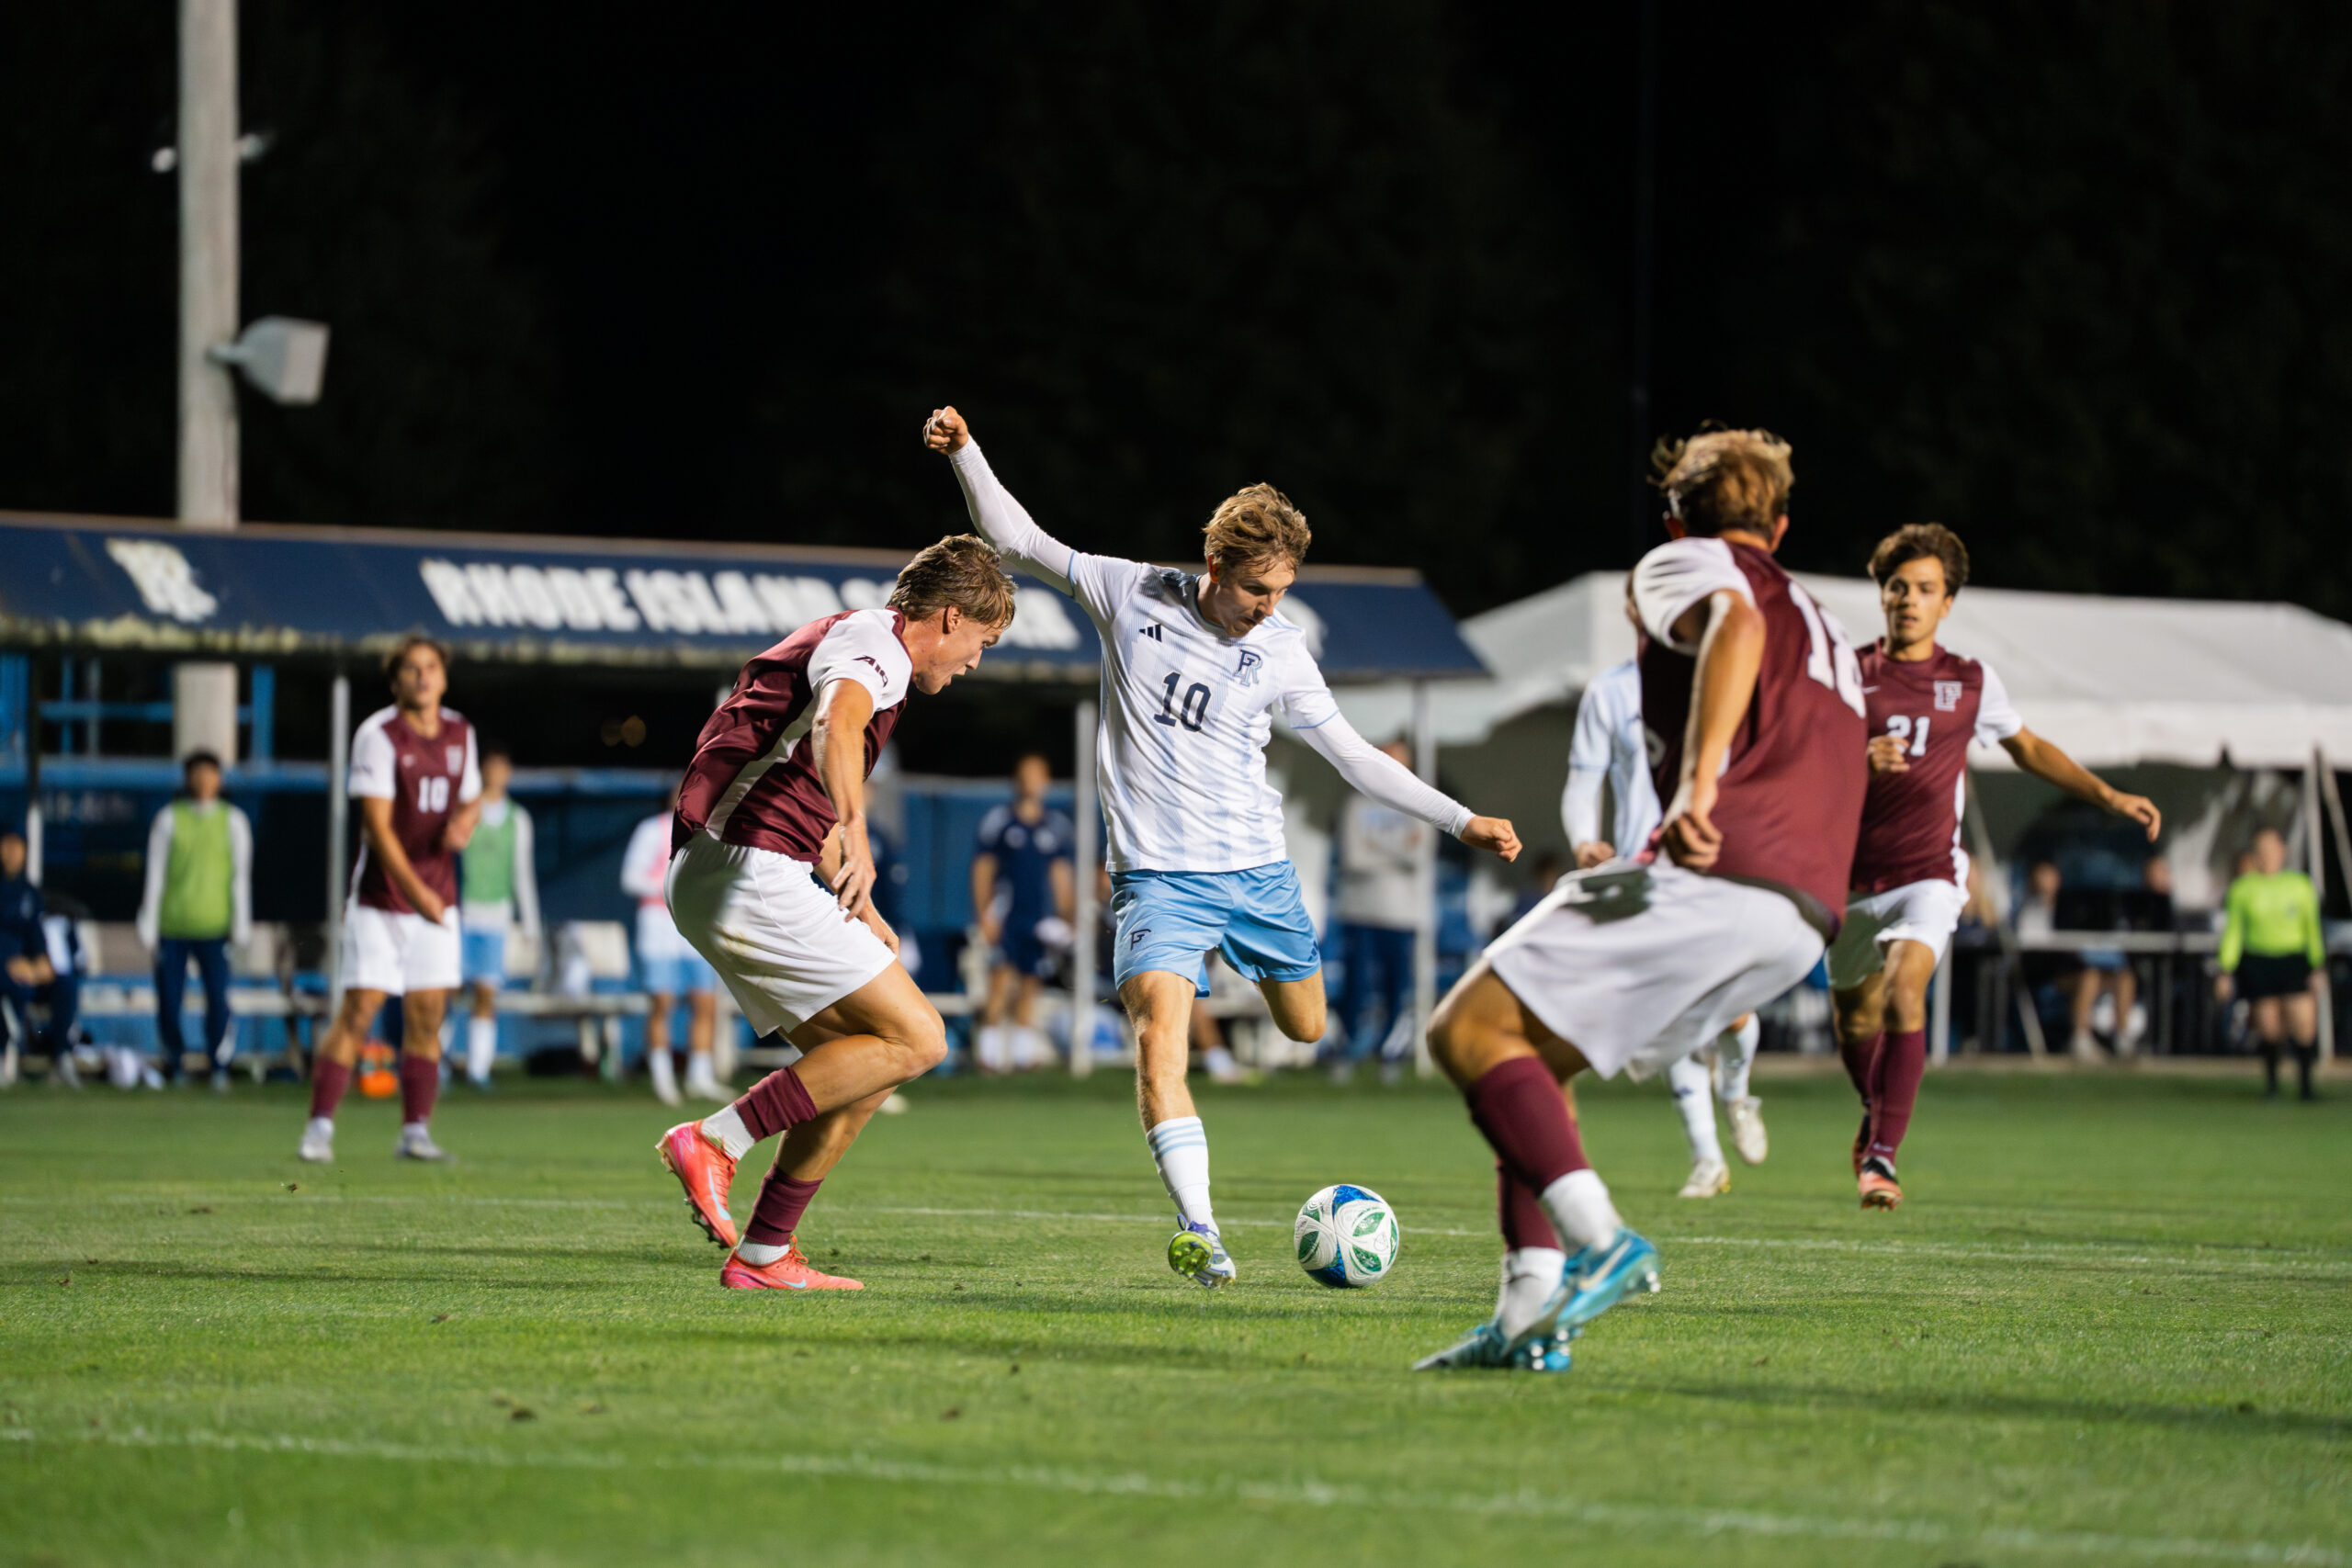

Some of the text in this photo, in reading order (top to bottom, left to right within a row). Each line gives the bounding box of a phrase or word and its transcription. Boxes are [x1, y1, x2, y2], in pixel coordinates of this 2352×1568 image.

[418, 558, 640, 632] RHODE
[624, 568, 843, 635] ISLAND
[1153, 671, 1212, 732] 10
[1886, 715, 1930, 756] 21
